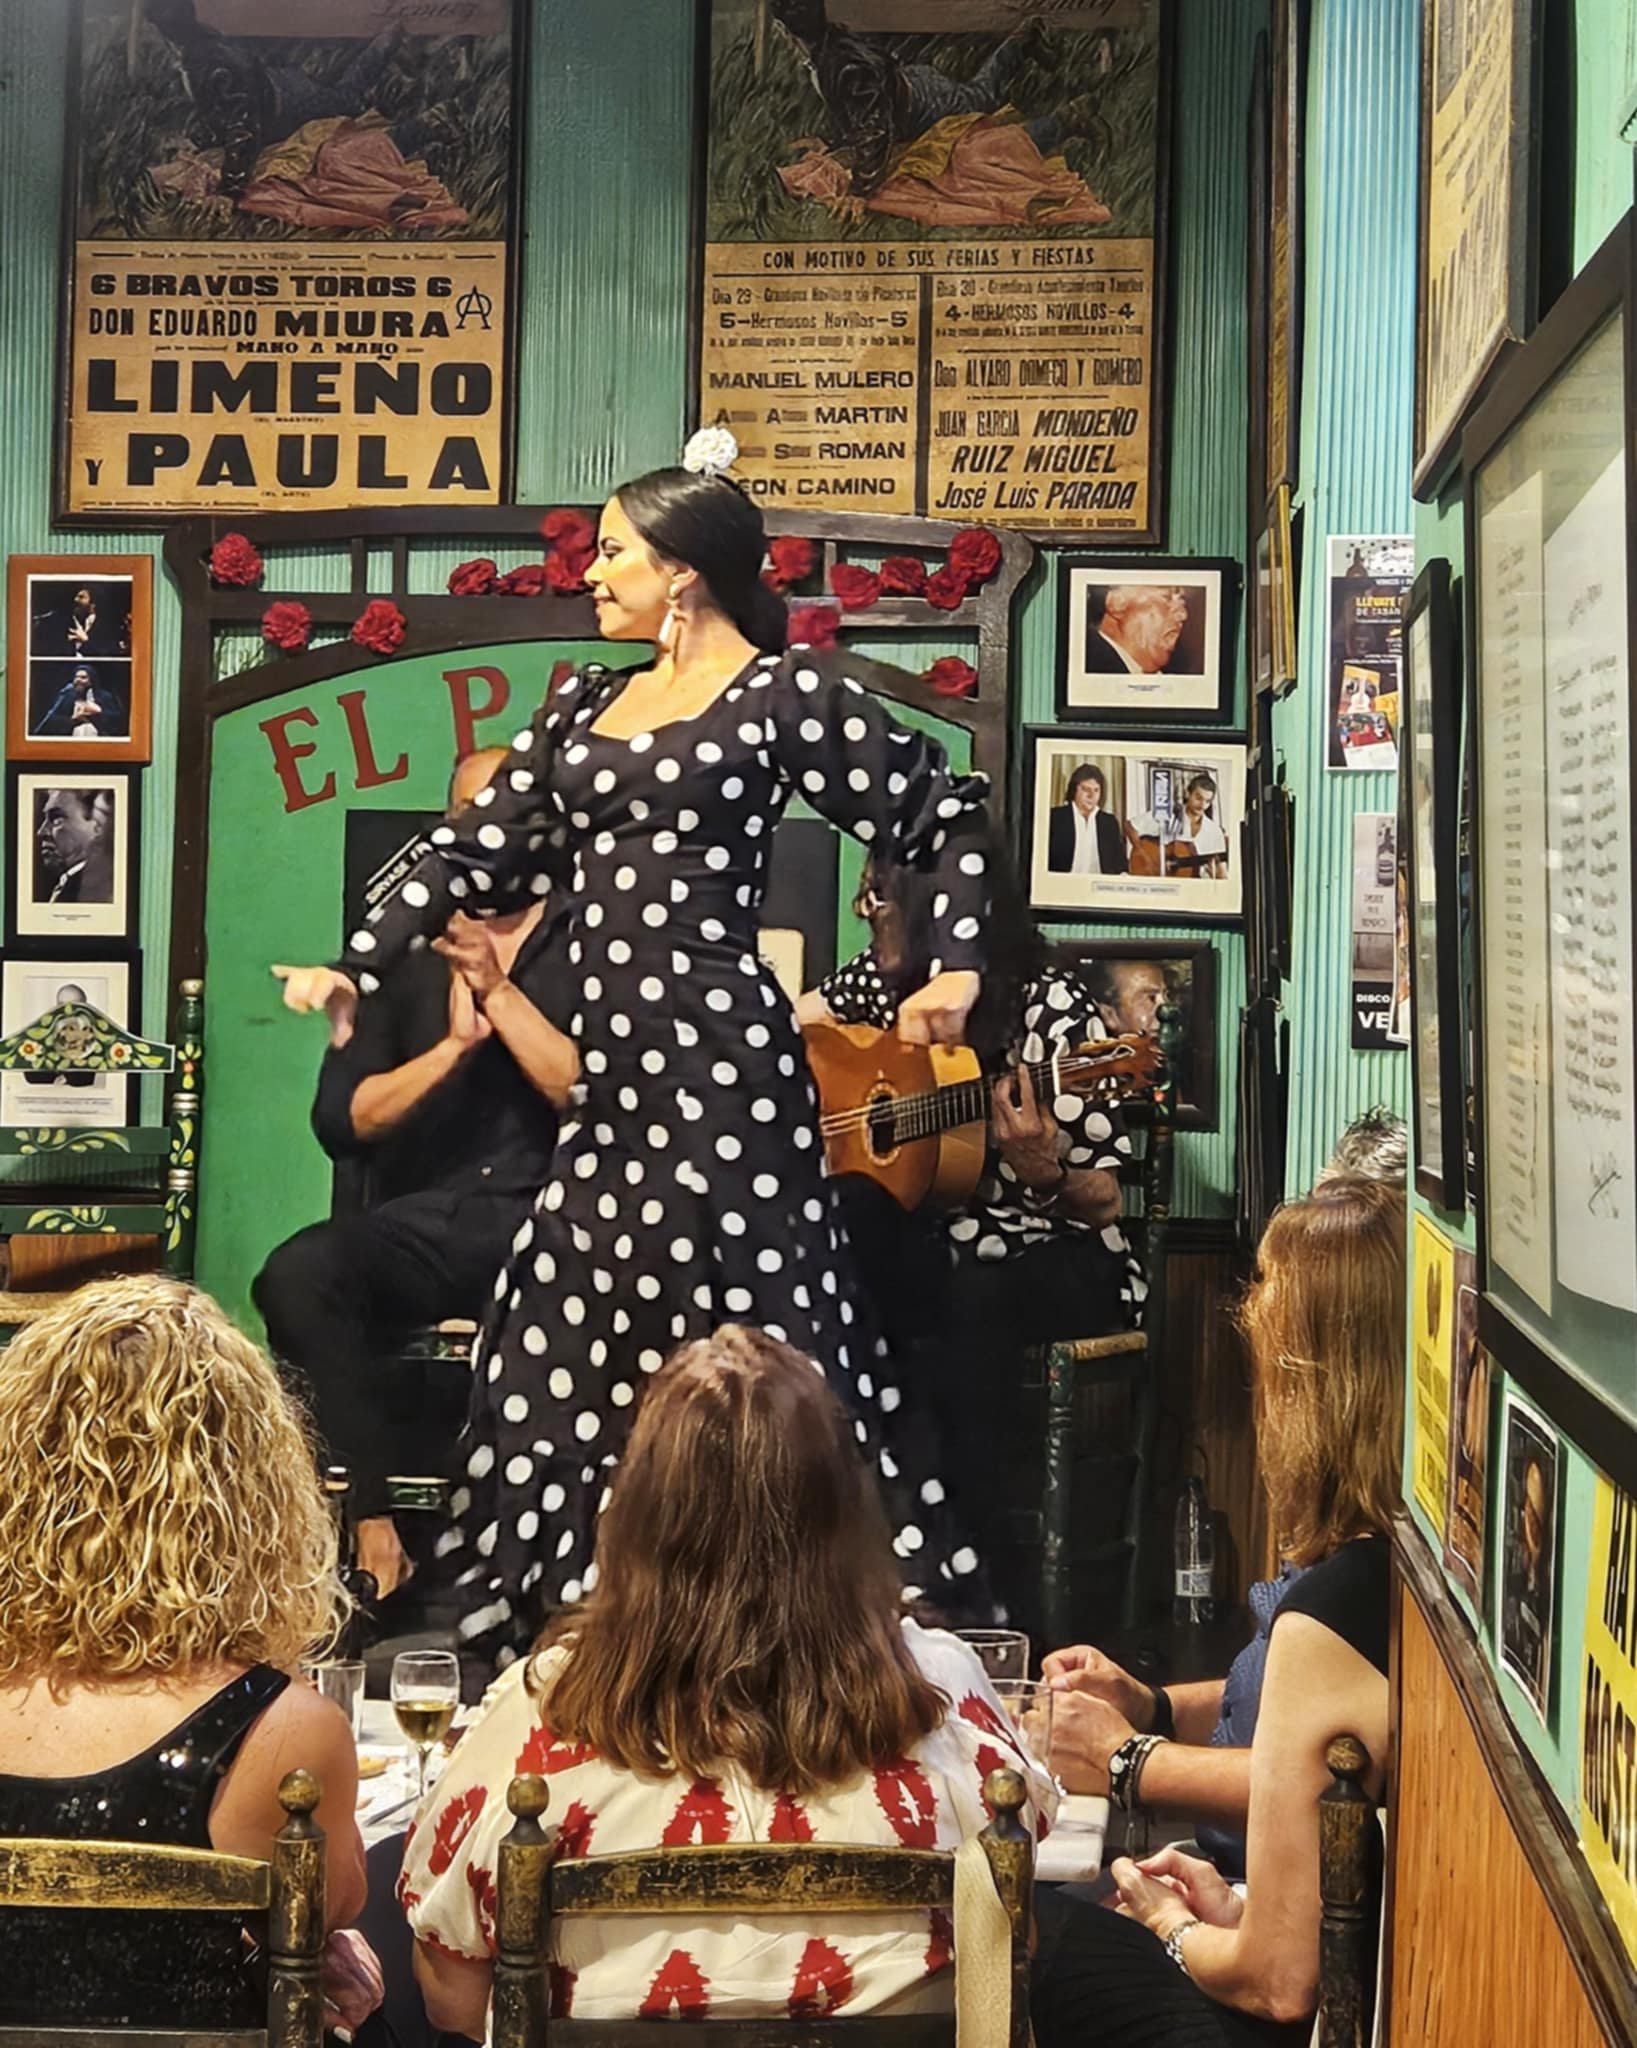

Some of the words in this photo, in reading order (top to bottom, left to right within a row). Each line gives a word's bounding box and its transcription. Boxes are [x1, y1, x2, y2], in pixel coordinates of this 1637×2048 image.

[763, 251, 794, 269] CON
[804, 250, 865, 268] MOTIVO
[876, 250, 895, 268] DE
[907, 249, 935, 267] SUS
[946, 249, 999, 267] FERIAS
[1011, 248, 1020, 266] Y
[1032, 247, 1095, 267] FIESTAS
[91, 274, 116, 296] 6
[126, 274, 279, 297] BRAVOS
[289, 275, 416, 297] TOROS
[426, 276, 452, 297] 6
[89, 307, 134, 336] DON
[149, 308, 257, 337] EDUARDO
[275, 310, 450, 338] MIURA
[310, 342, 324, 354] A
[87, 354, 493, 416] LIMEÑO
[709, 371, 807, 389] MANUEL
[815, 370, 914, 389] MULERO
[1077, 359, 1085, 386] Y
[815, 407, 908, 424] MARTIN
[934, 410, 966, 438] JUAN
[976, 409, 1020, 438] GARCIA
[1032, 406, 1138, 438] MONDEÑO
[85, 459, 103, 486] Y
[126, 433, 491, 491] PAULA
[819, 442, 906, 460] ROMAN
[950, 445, 1015, 473] RUIZ
[1023, 445, 1117, 473] MIGUEL
[797, 478, 895, 496] CAMINO
[935, 481, 987, 509] José
[993, 480, 1039, 509] Luis
[1045, 481, 1138, 509] PARADA
[258, 689, 409, 813] EL
[1357, 1010, 1391, 1030] VE
[1583, 1651, 1637, 1889] MOST
